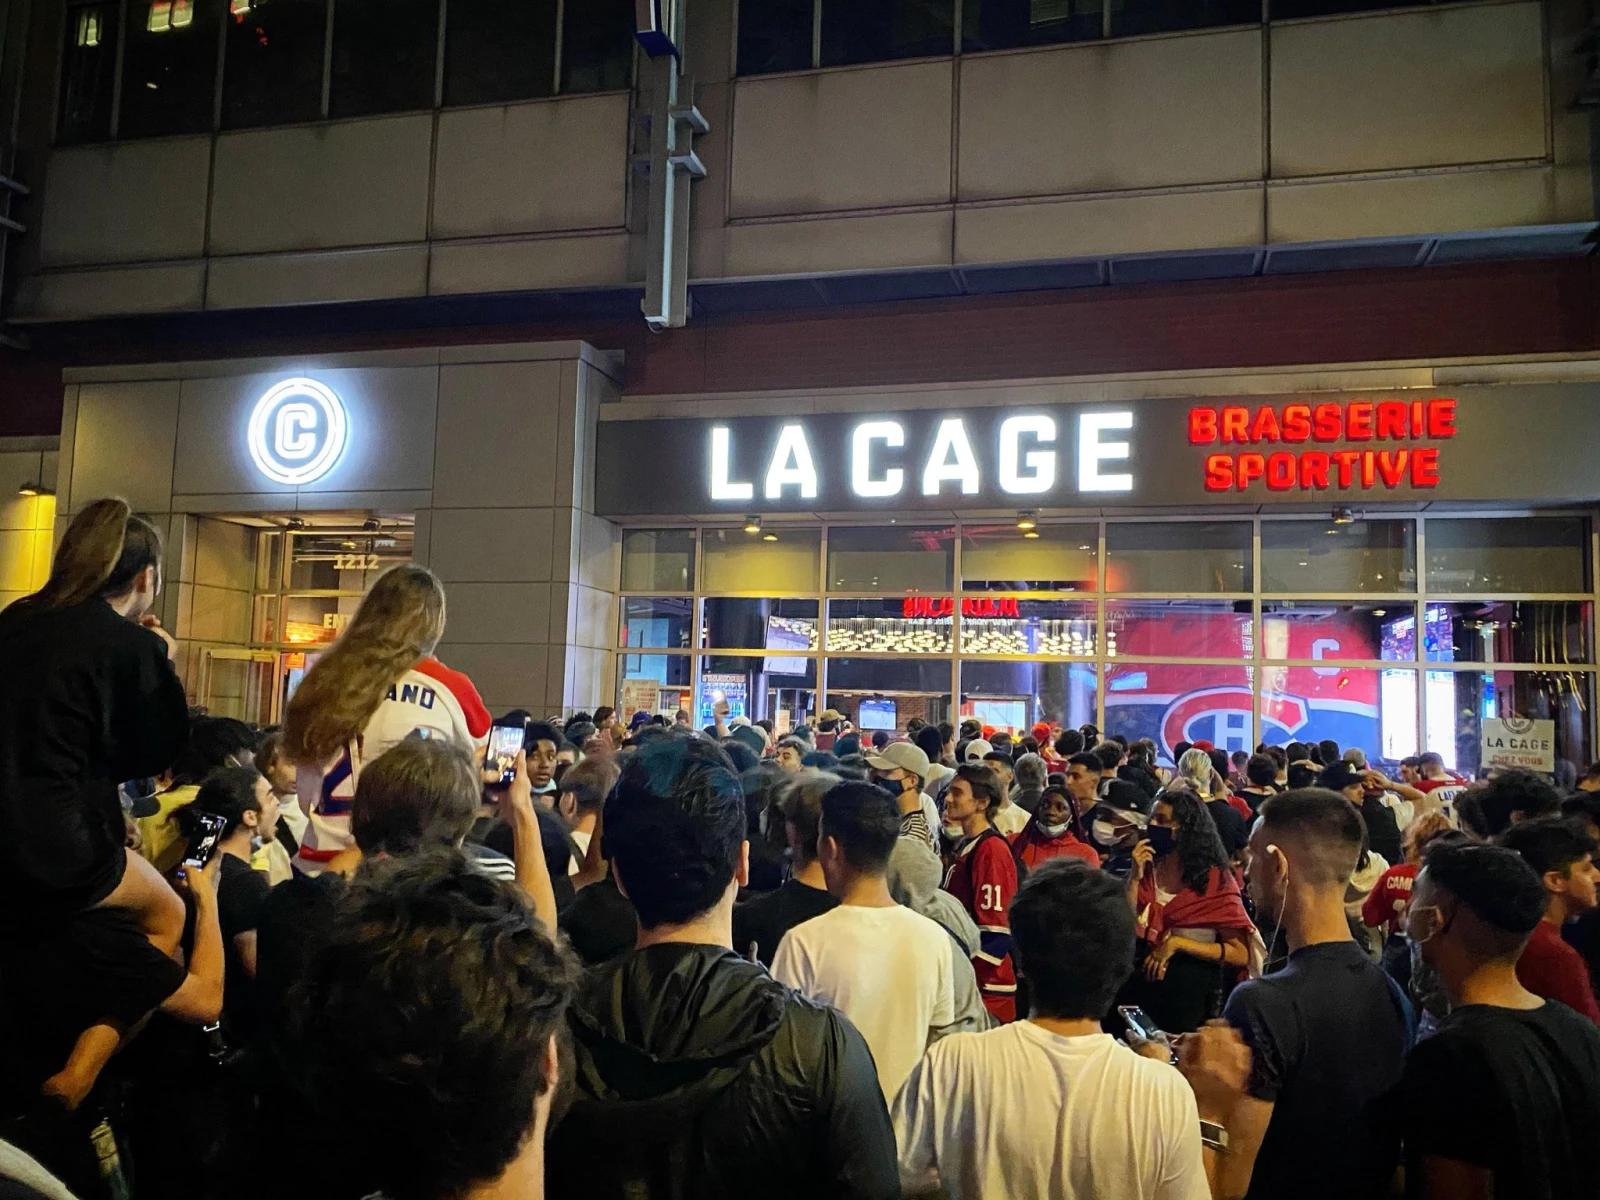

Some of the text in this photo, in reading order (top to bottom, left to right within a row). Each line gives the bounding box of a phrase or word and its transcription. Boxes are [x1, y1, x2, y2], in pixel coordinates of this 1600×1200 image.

[275, 403, 316, 459] C
[1189, 400, 1457, 444] BRASSERIE
[710, 411, 1133, 500] LA CAGE
[1205, 448, 1440, 490] SPORTIVE
[333, 554, 379, 570] 1212
[1311, 637, 1341, 677] C
[1487, 736, 1549, 751] LA CAGE
[1518, 755, 1543, 765] VOUS
[980, 884, 1003, 912] 31
